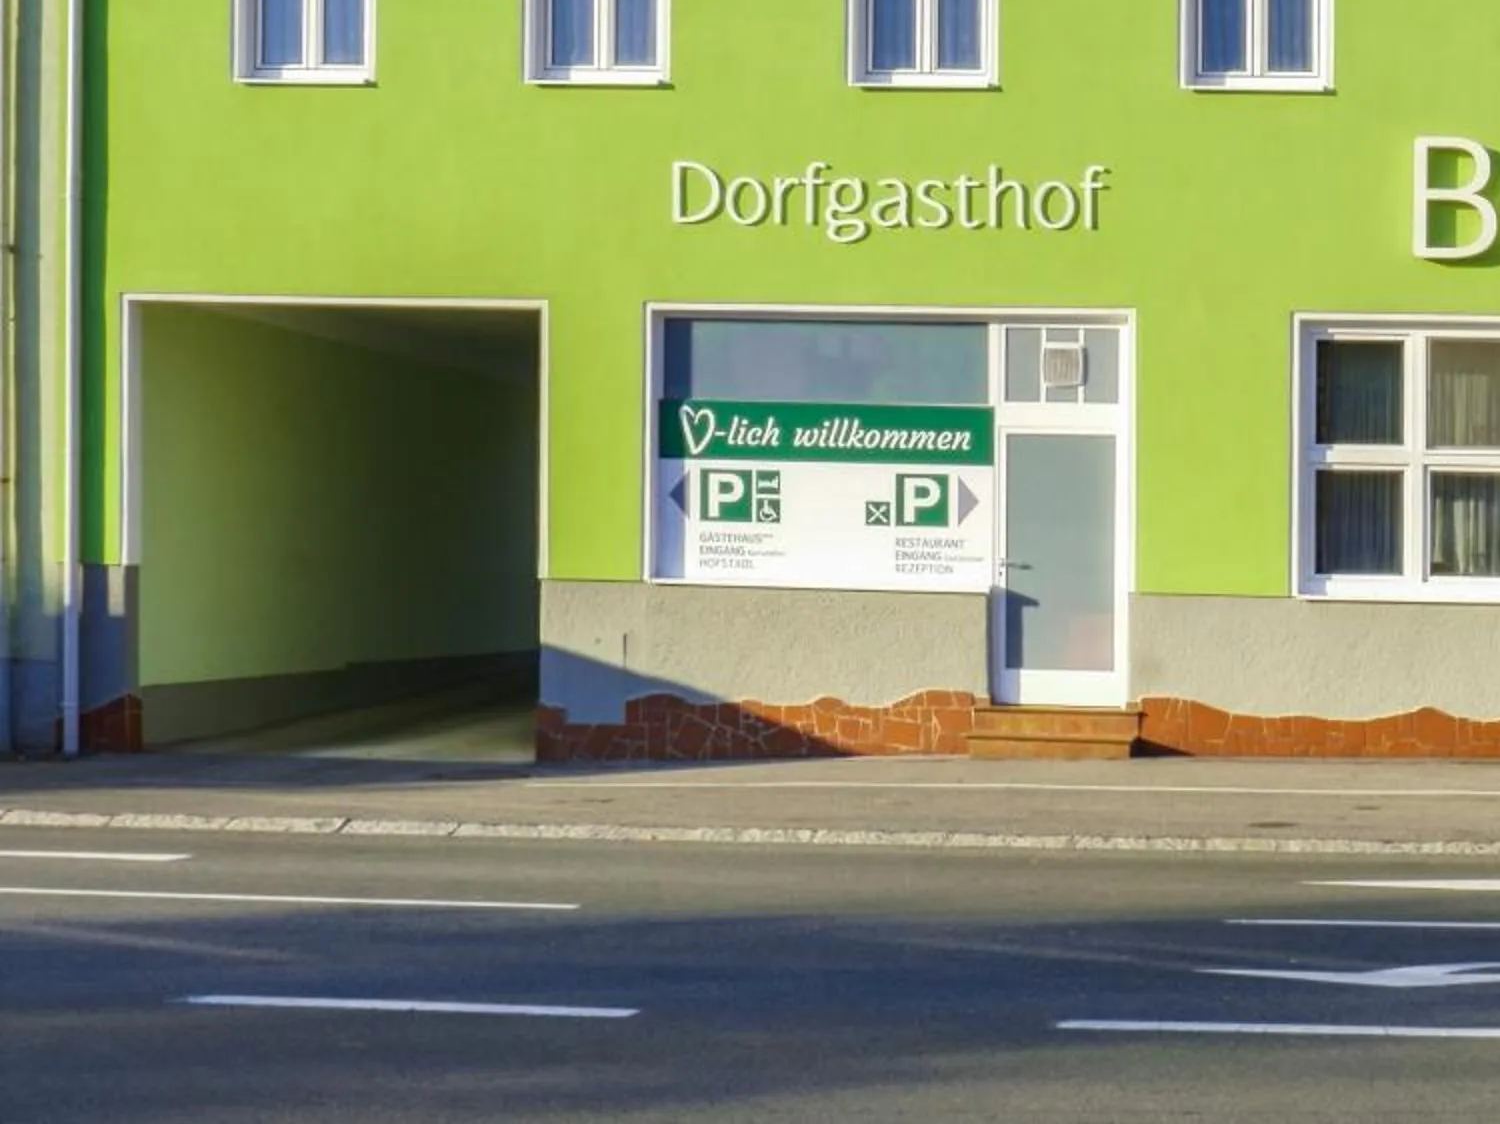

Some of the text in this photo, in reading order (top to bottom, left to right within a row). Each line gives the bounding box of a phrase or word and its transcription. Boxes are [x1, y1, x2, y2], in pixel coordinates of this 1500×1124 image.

[671, 160, 1106, 243] Dorfgasthof
[793, 419, 972, 452] willkommen
[706, 473, 745, 518] P
[903, 477, 942, 523] P
[895, 537, 966, 549] RESTAURANT
